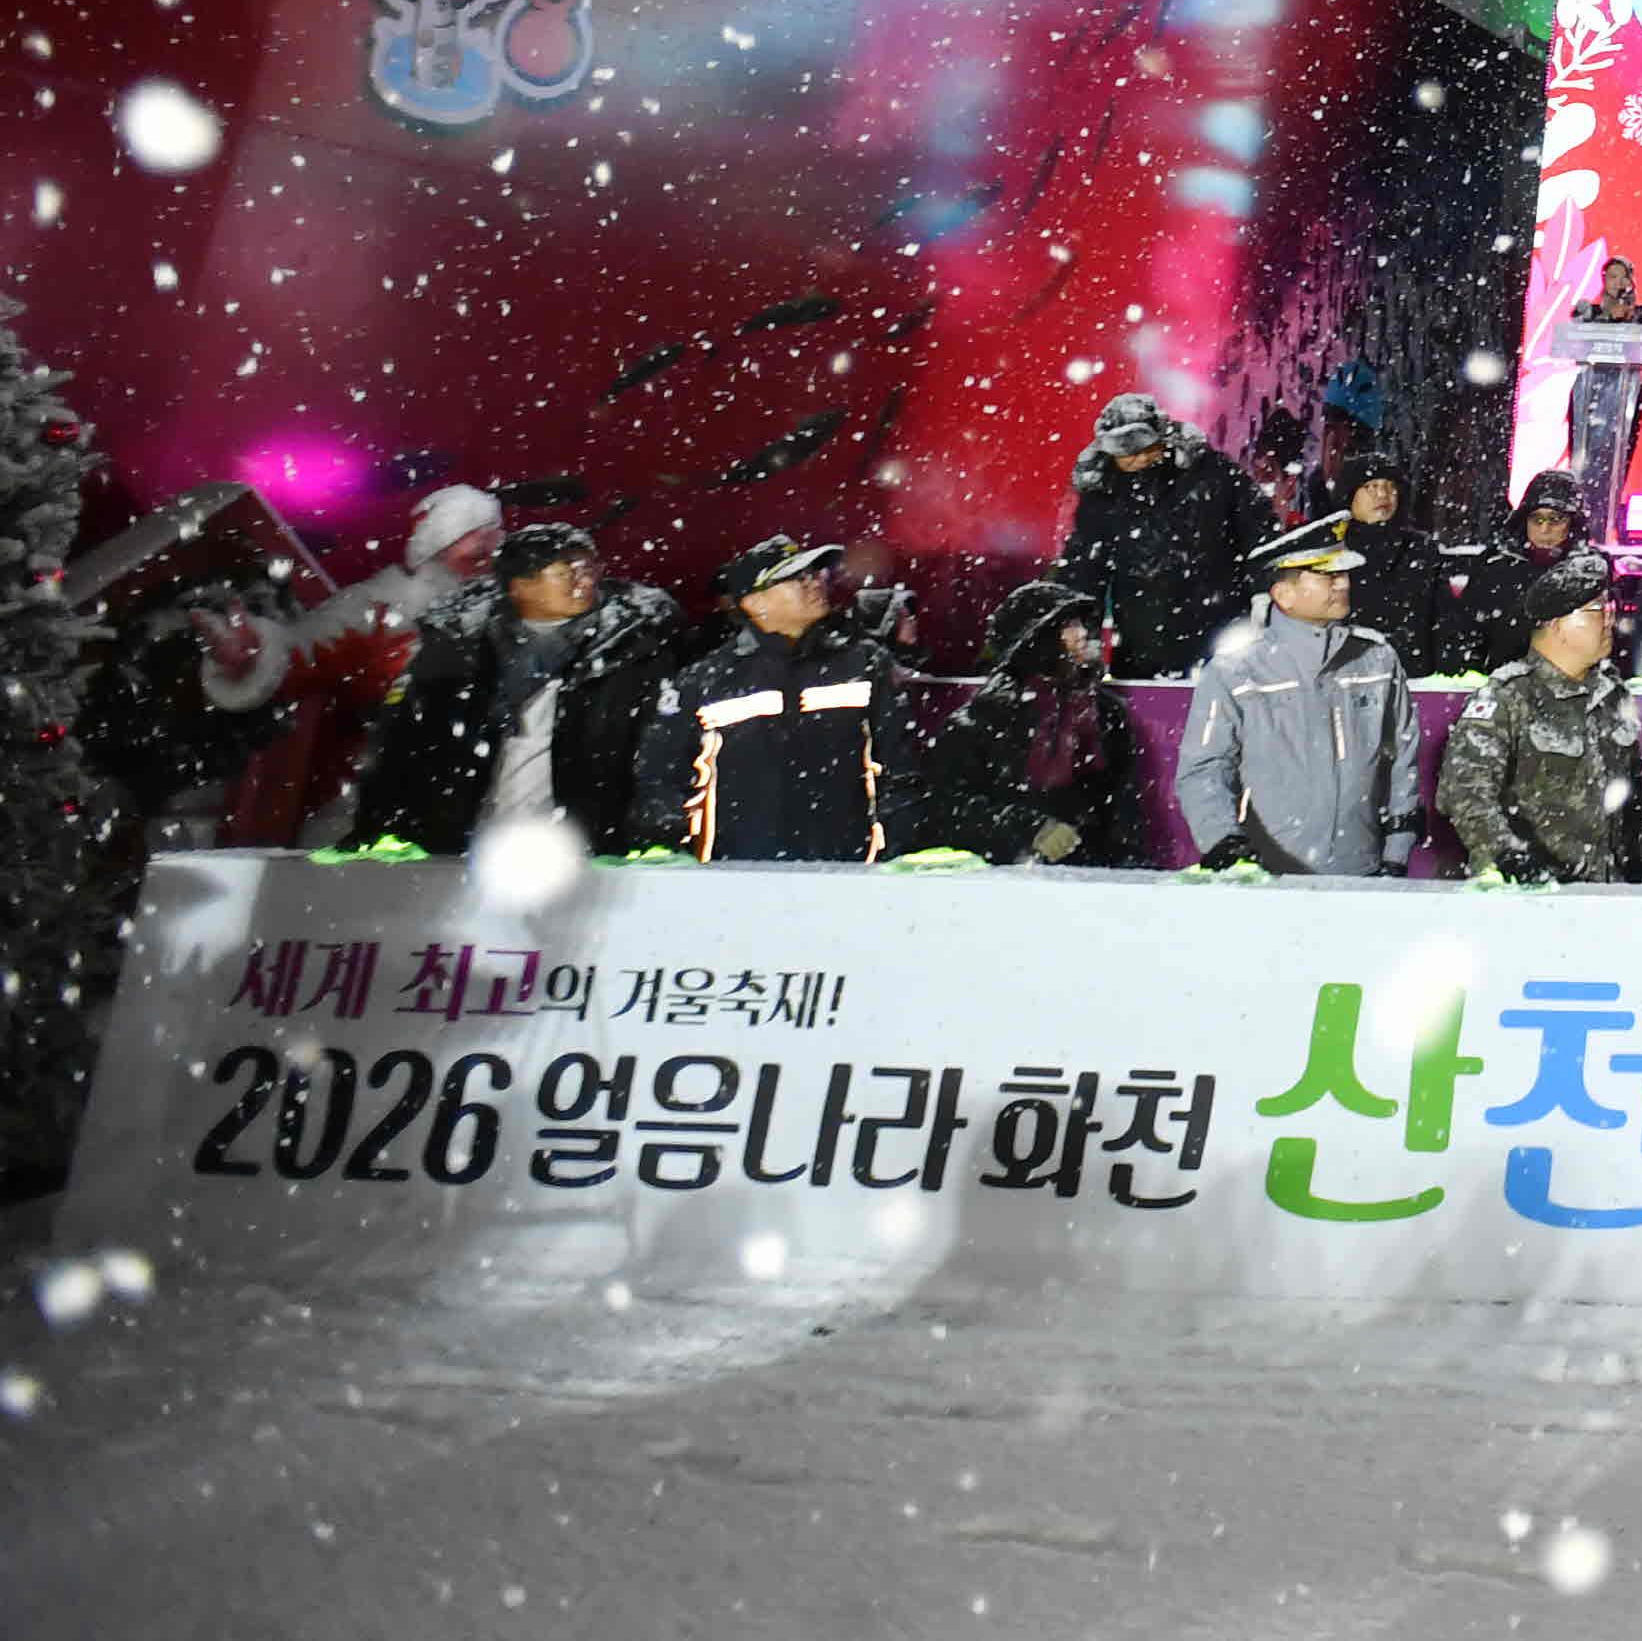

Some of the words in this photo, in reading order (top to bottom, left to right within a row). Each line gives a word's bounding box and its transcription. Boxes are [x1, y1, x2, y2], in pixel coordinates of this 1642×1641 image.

[229, 938, 379, 1020] 세계
[395, 943, 592, 1022] 최고의
[611, 966, 843, 1030] 겨울축제!
[192, 1045, 512, 1186] 2026
[531, 1051, 967, 1193] 얼음나라
[981, 1067, 1216, 1210] 화천
